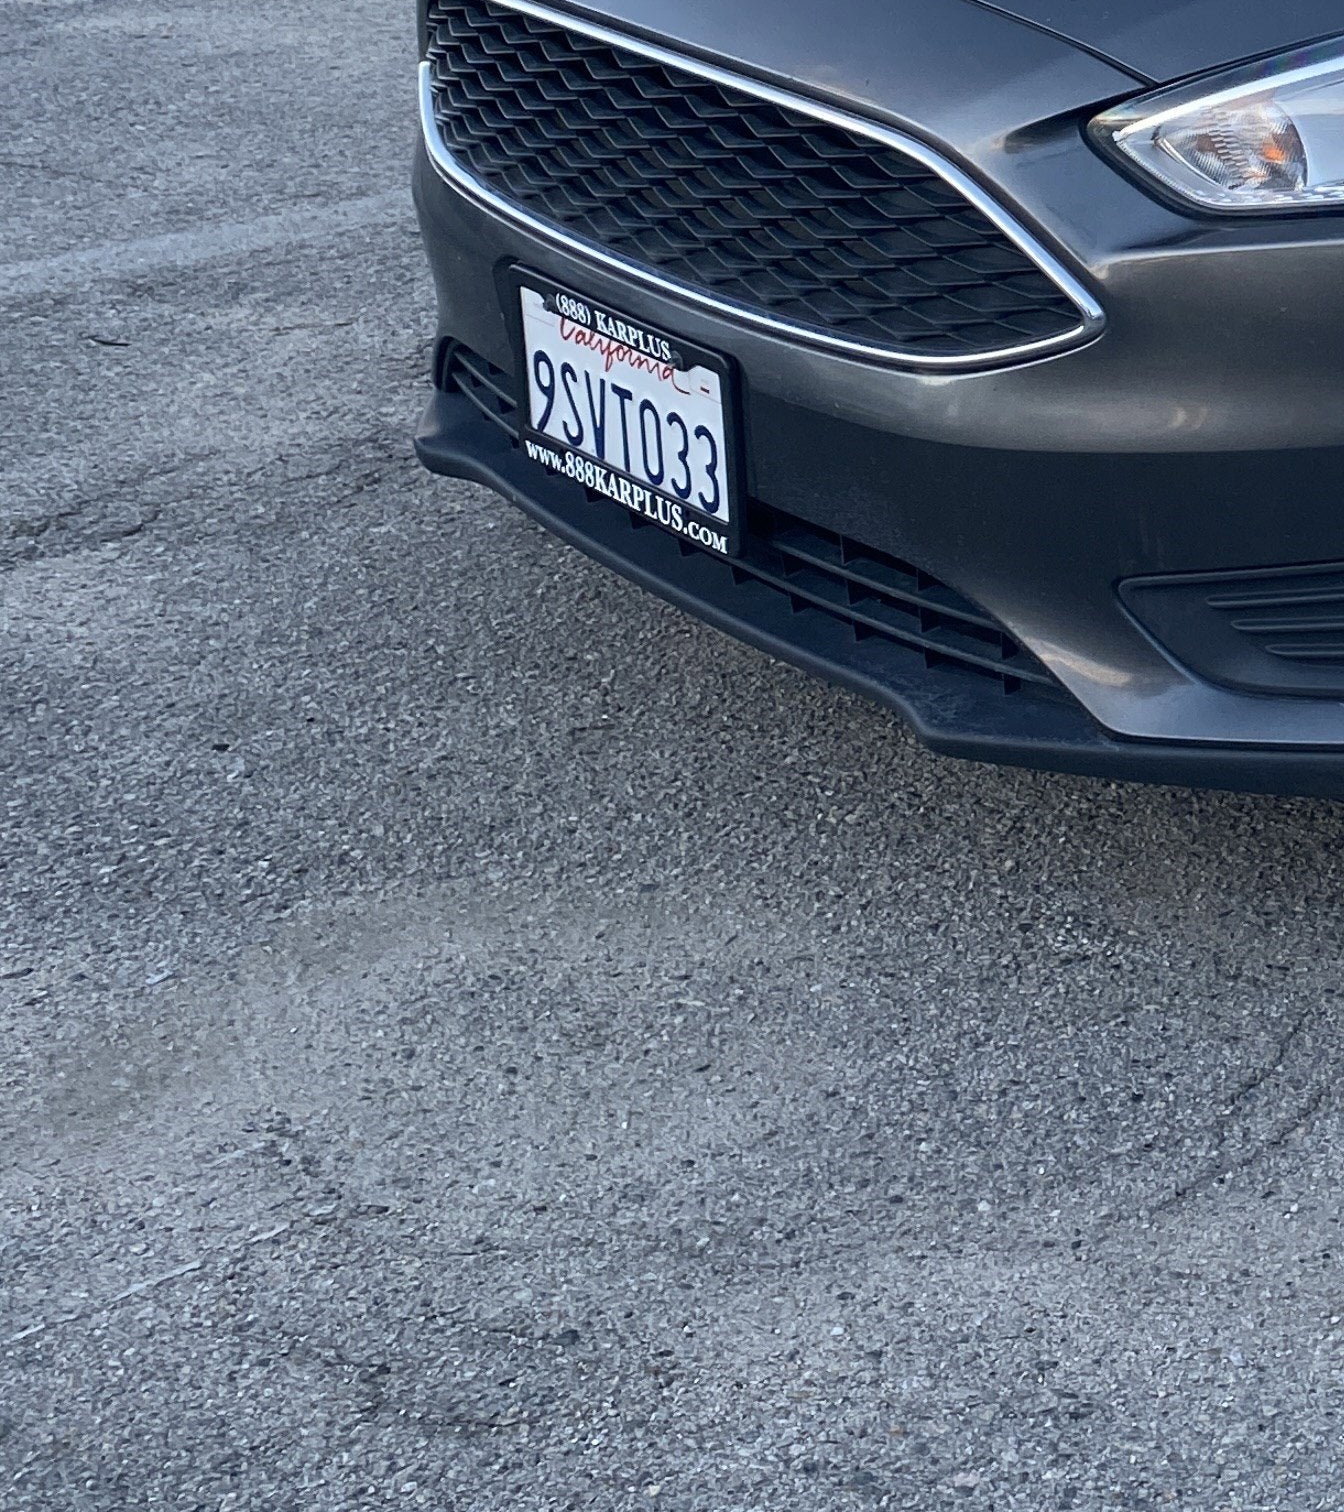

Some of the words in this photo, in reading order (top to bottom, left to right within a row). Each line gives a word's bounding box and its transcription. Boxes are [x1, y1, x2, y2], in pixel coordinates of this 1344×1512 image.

[556, 292, 591, 326] (888)
[594, 310, 672, 361] KARPLUS
[560, 317, 691, 396] California
[533, 349, 720, 515] 9SVT033
